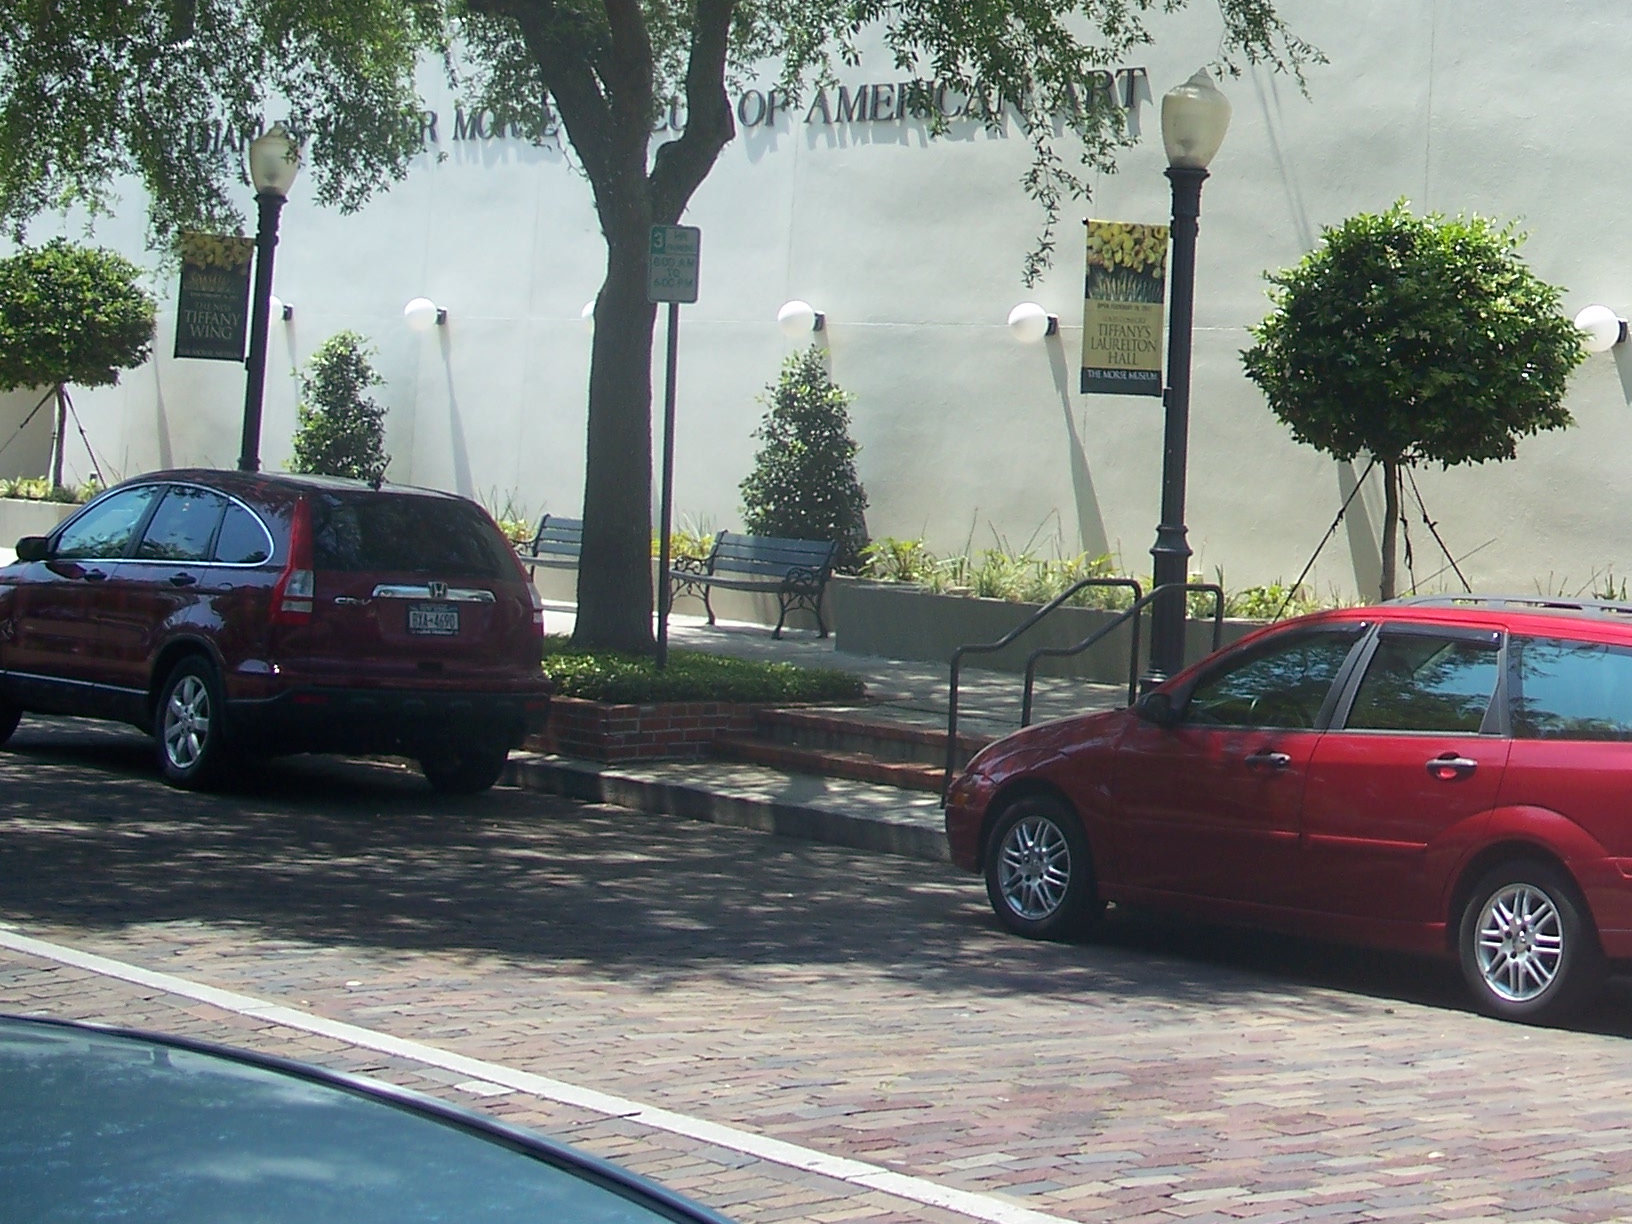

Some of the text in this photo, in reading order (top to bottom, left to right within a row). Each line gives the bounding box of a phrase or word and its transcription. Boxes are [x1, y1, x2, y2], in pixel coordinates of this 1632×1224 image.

[453, 102, 559, 140] MORE
[653, 232, 663, 248] 3
[184, 310, 241, 327] TIFFANY
[190, 324, 233, 340] WING
[1090, 336, 1158, 353] LAURELTON
[1108, 351, 1139, 366] HALL
[1086, 369, 1102, 379] THE
[1103, 370, 1127, 381] MORSE
